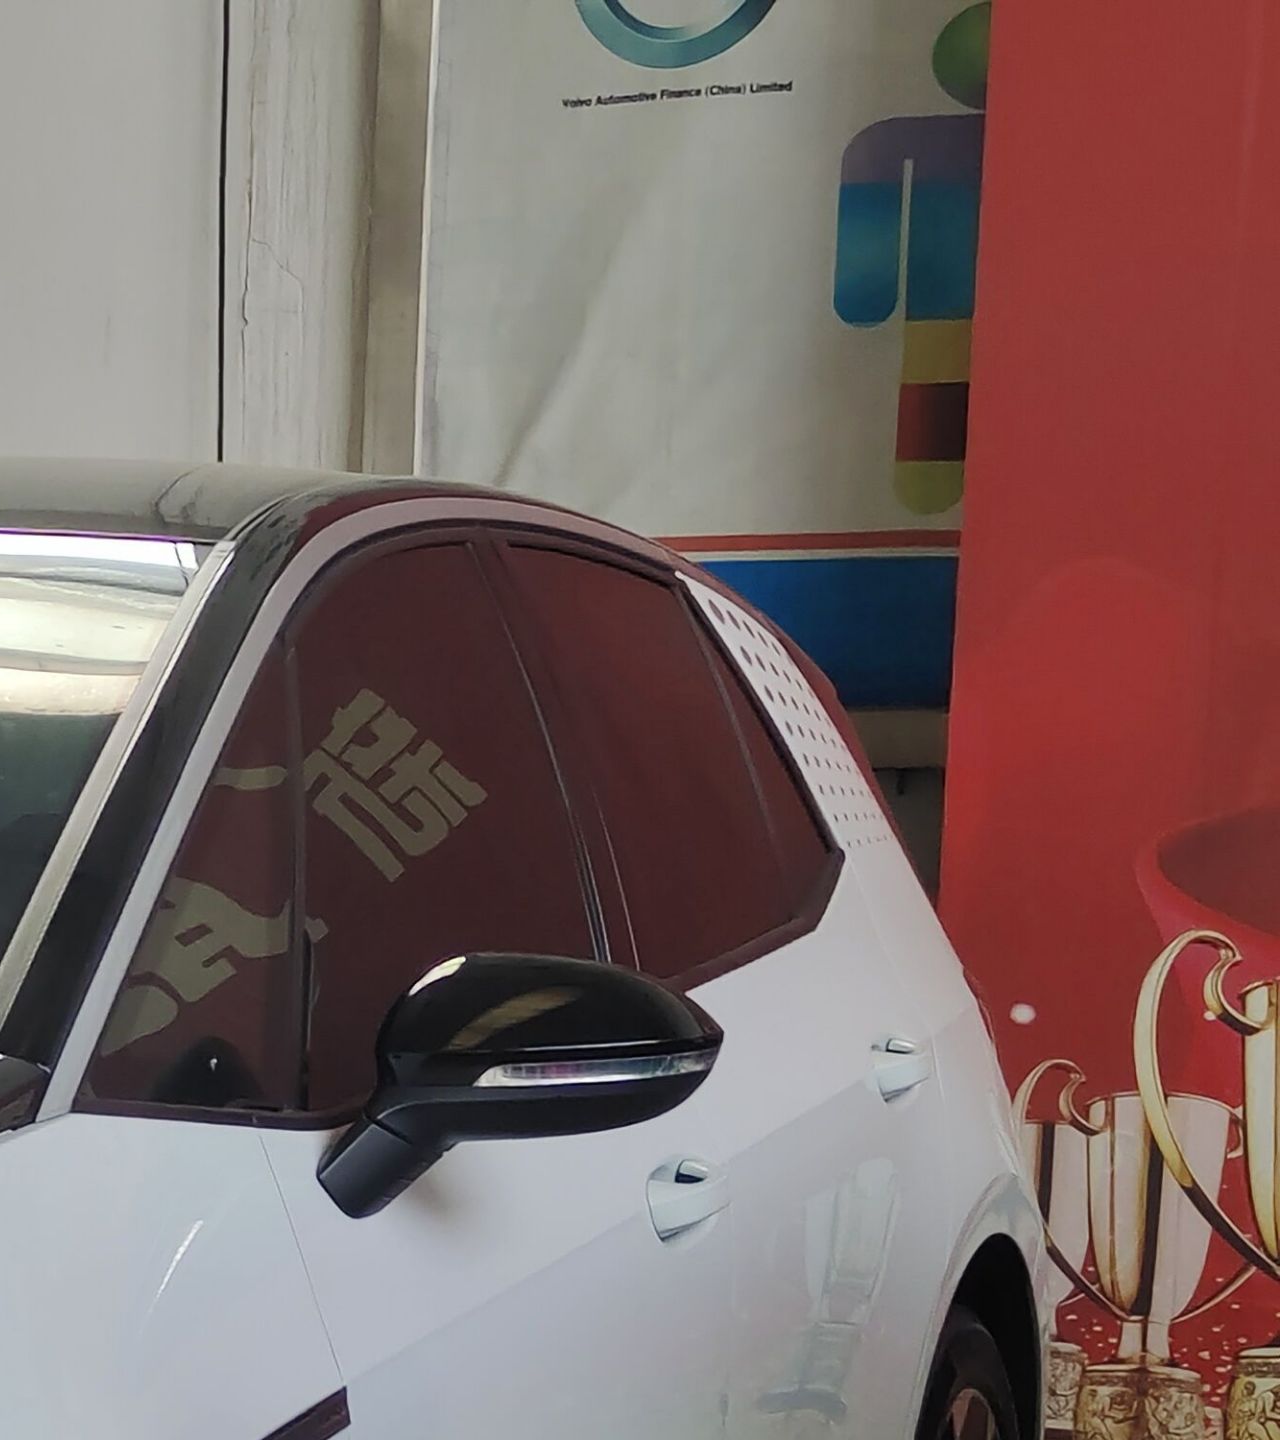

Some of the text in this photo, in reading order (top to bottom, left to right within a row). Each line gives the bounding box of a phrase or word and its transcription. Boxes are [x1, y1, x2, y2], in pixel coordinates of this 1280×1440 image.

[561, 97, 592, 108] Volvo
[595, 92, 657, 106] Automotive
[750, 80, 793, 94] Limited
